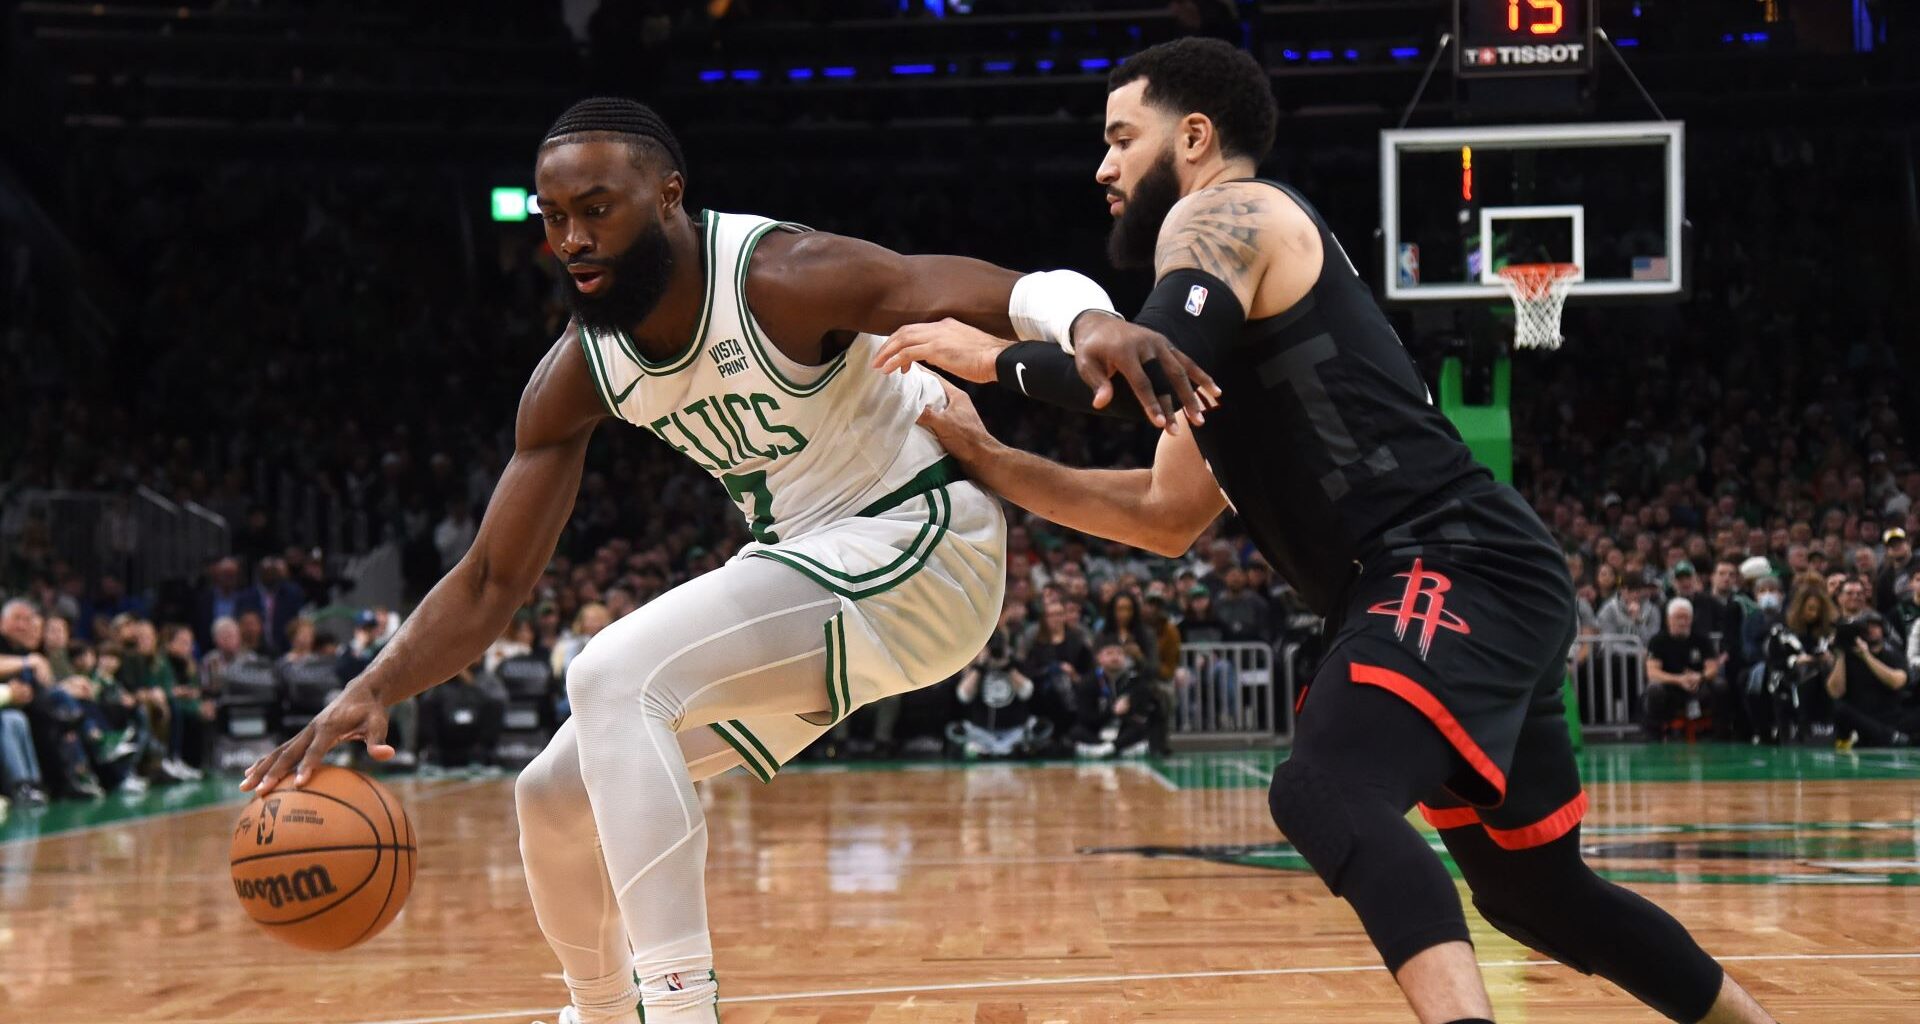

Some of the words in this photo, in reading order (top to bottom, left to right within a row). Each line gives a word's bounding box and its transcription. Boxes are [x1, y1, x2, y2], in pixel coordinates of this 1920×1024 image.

[1498, 44, 1584, 65] TISSOT
[708, 338, 745, 365] VISTA
[717, 356, 750, 379] PRINT
[650, 392, 810, 471] ELTICS
[720, 469, 780, 546] 7
[234, 864, 338, 909] Wilson
